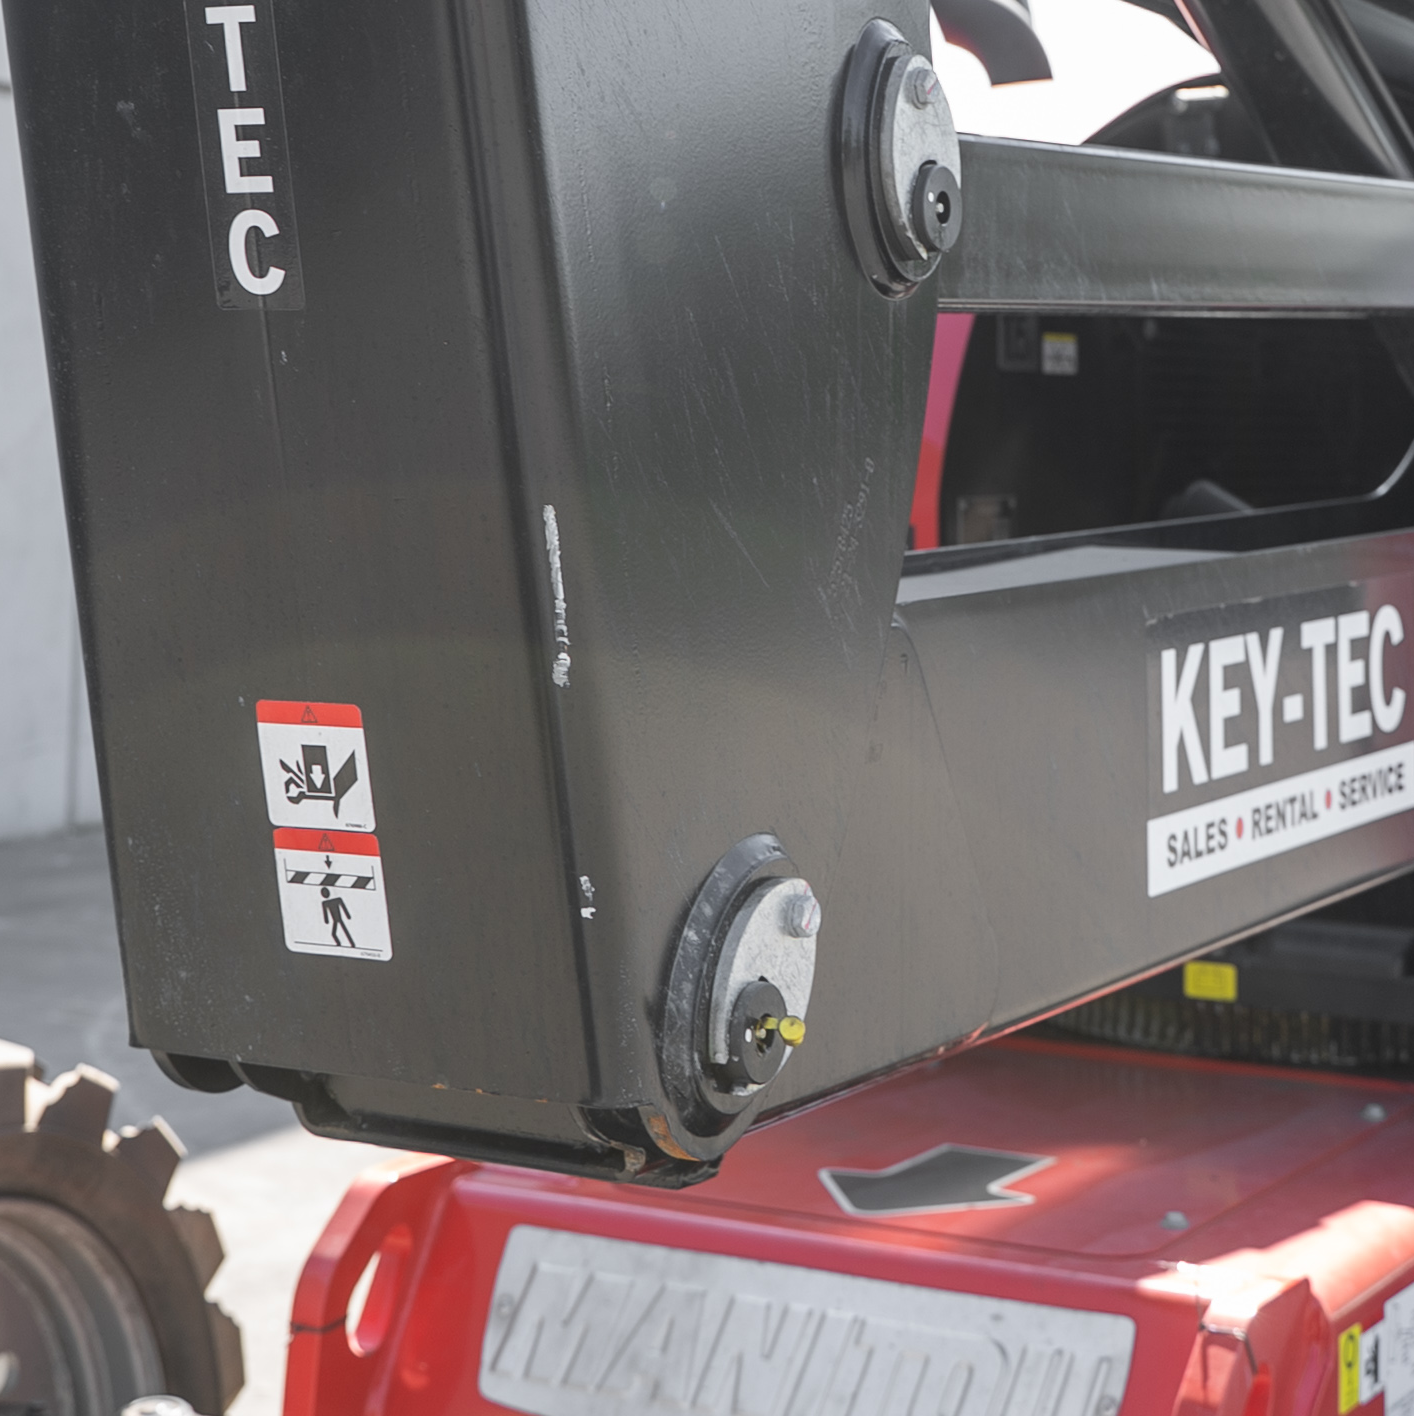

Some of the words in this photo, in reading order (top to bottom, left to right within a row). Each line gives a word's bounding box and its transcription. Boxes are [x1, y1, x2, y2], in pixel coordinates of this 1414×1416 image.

[1161, 604, 1407, 795] KEY-TEC
[1166, 817, 1229, 869] SALES
[1251, 790, 1320, 841] RENTAL
[1338, 762, 1406, 811] SERVICE
